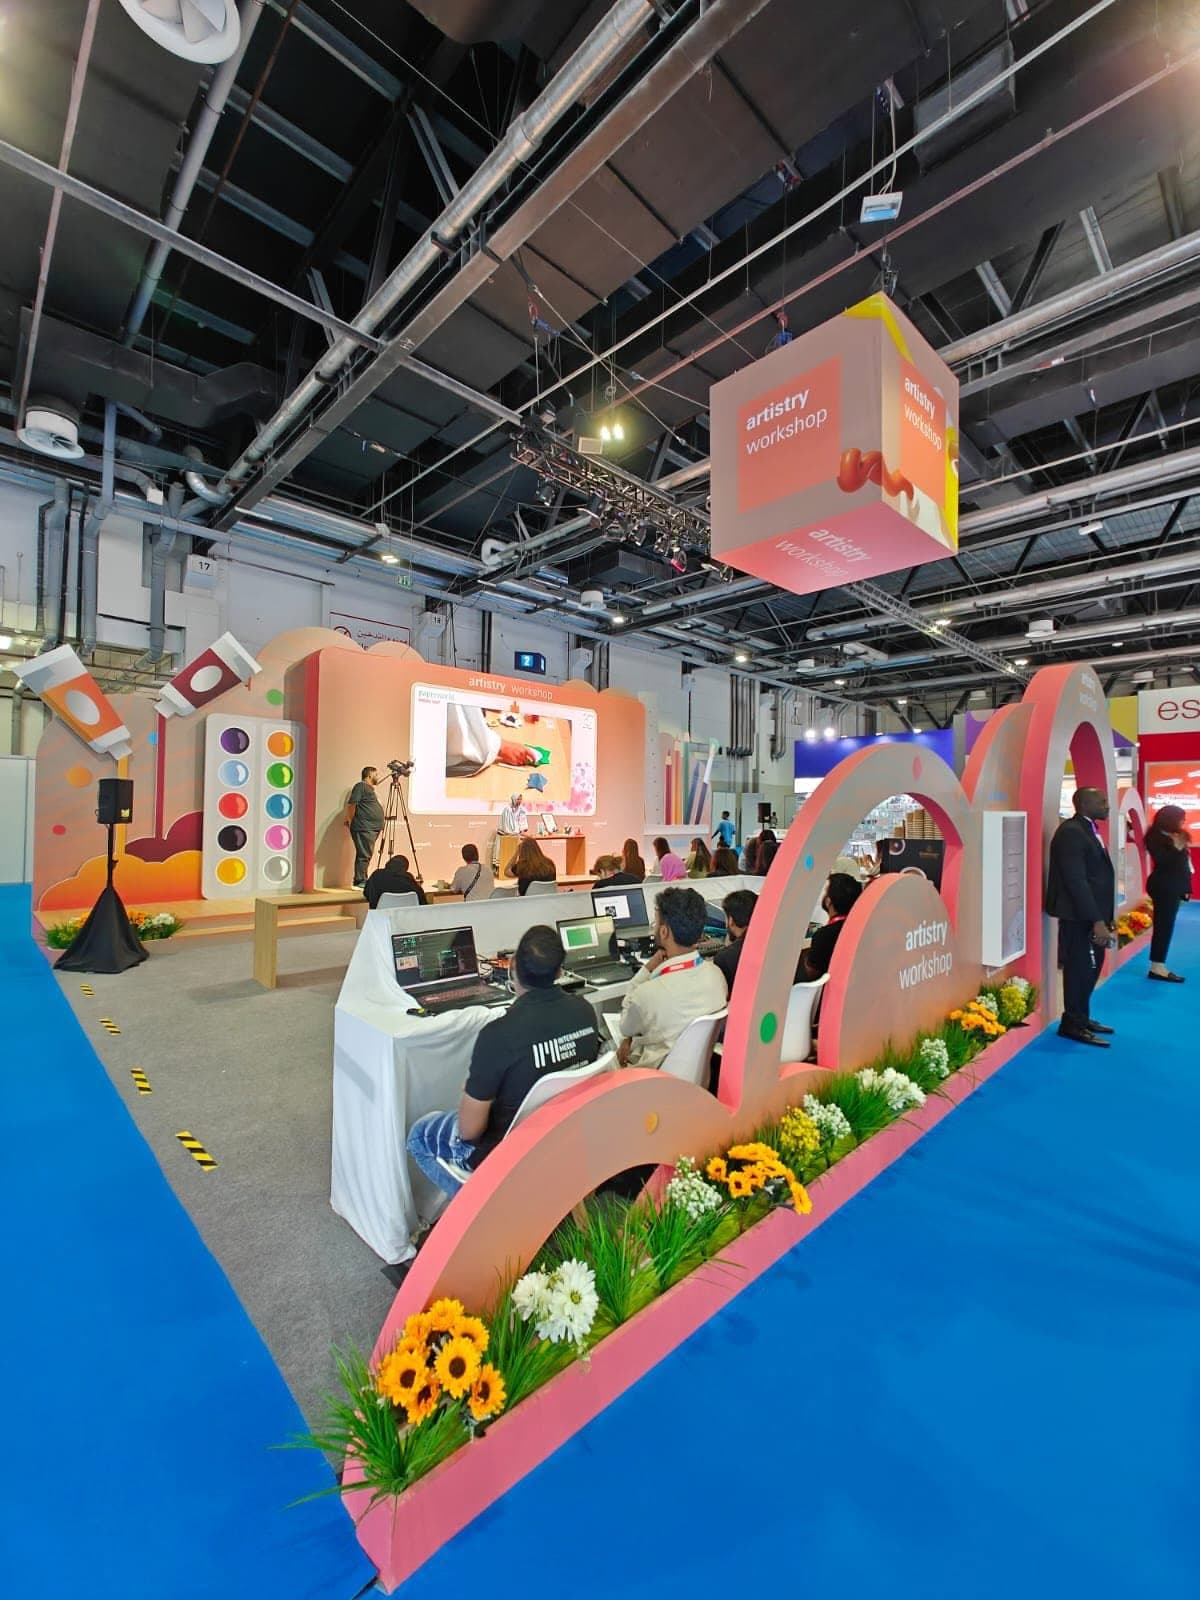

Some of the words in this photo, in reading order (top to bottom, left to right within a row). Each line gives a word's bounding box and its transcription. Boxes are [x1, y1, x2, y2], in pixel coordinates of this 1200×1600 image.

[746, 388, 810, 431] artistry
[904, 377, 936, 421] artistry
[746, 408, 828, 455] workshop
[904, 402, 943, 453] workshop
[775, 540, 849, 577] workshop
[808, 529, 872, 562] artistry
[199, 562, 210, 570] 17
[523, 655, 531, 666] 2
[468, 677, 506, 693] artistry
[511, 684, 553, 701] workshop
[905, 920, 948, 952] artistry
[899, 951, 953, 990] workshop
